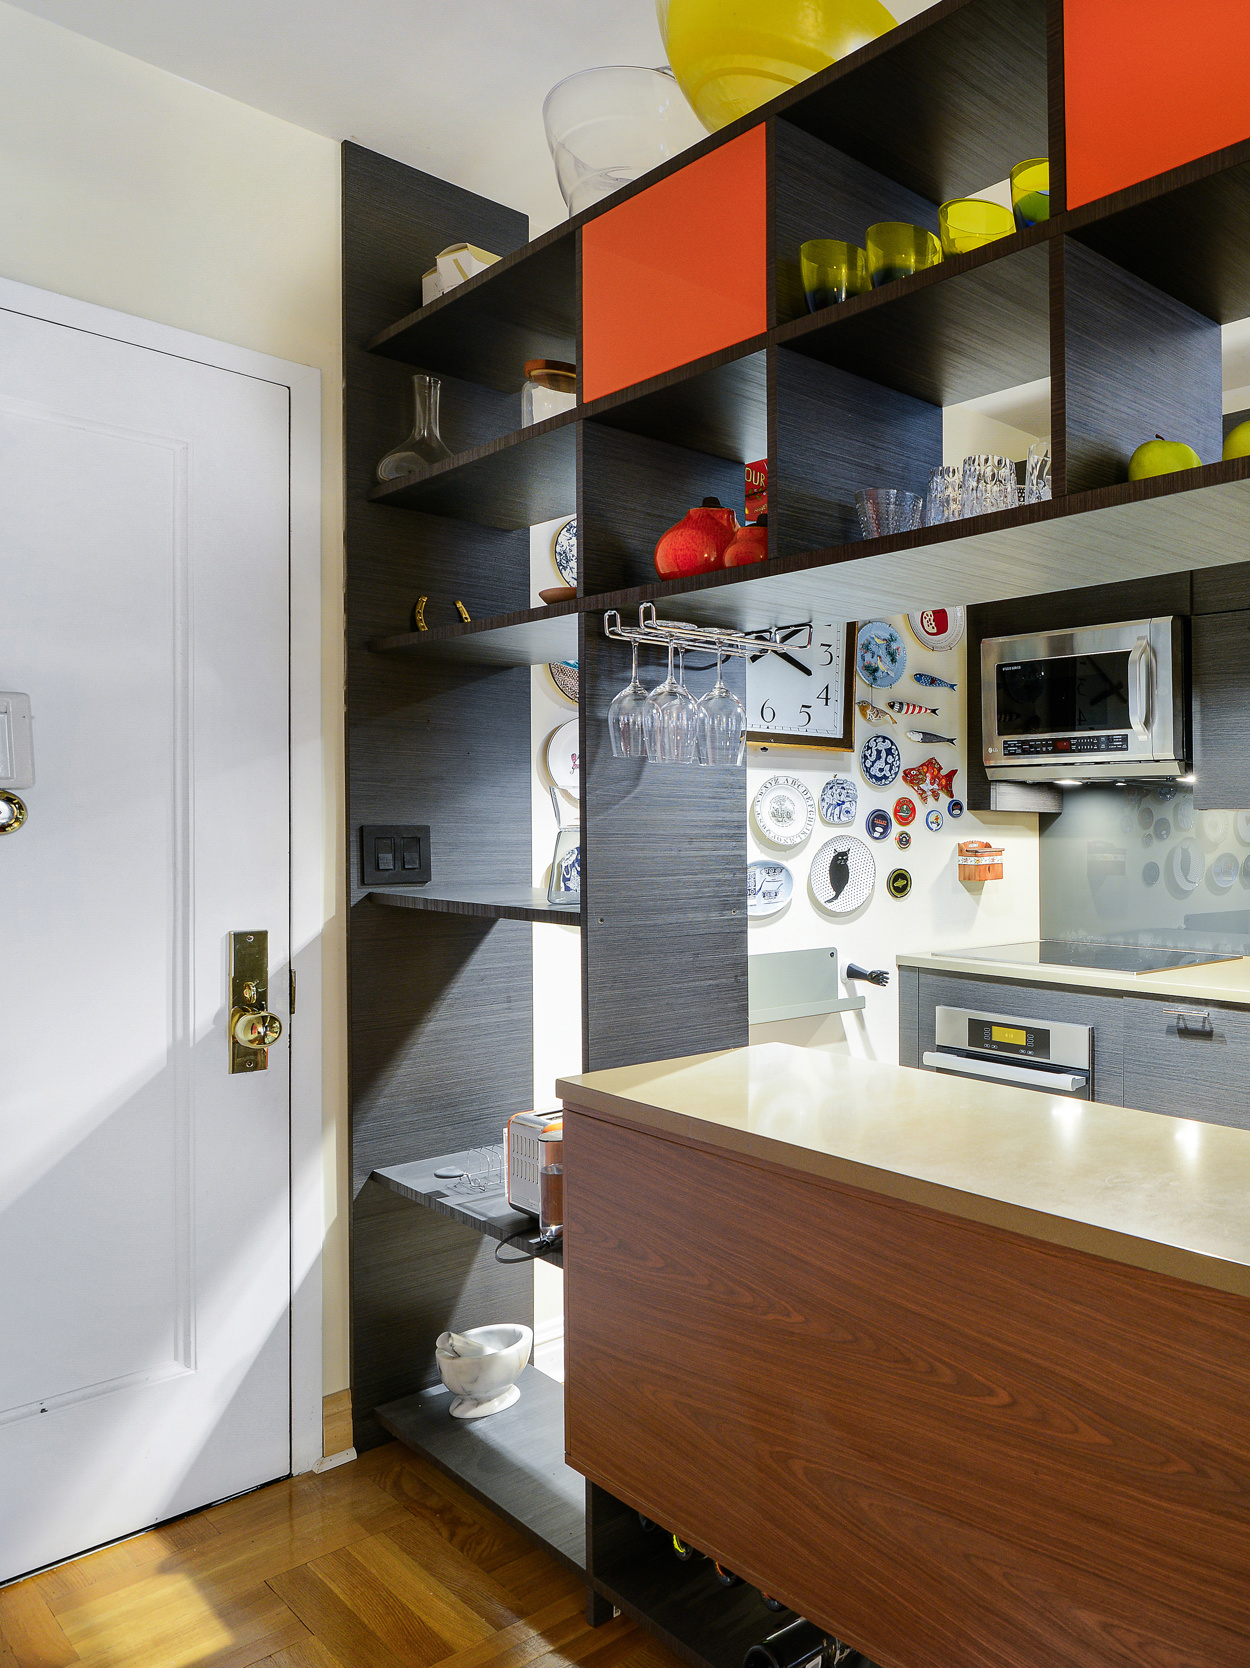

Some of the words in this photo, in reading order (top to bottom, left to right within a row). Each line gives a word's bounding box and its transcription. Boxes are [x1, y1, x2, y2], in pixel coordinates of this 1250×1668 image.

[819, 643, 833, 666] 3
[816, 683, 831, 706] 4
[760, 698, 776, 723] 6
[798, 704, 812, 728] 5
